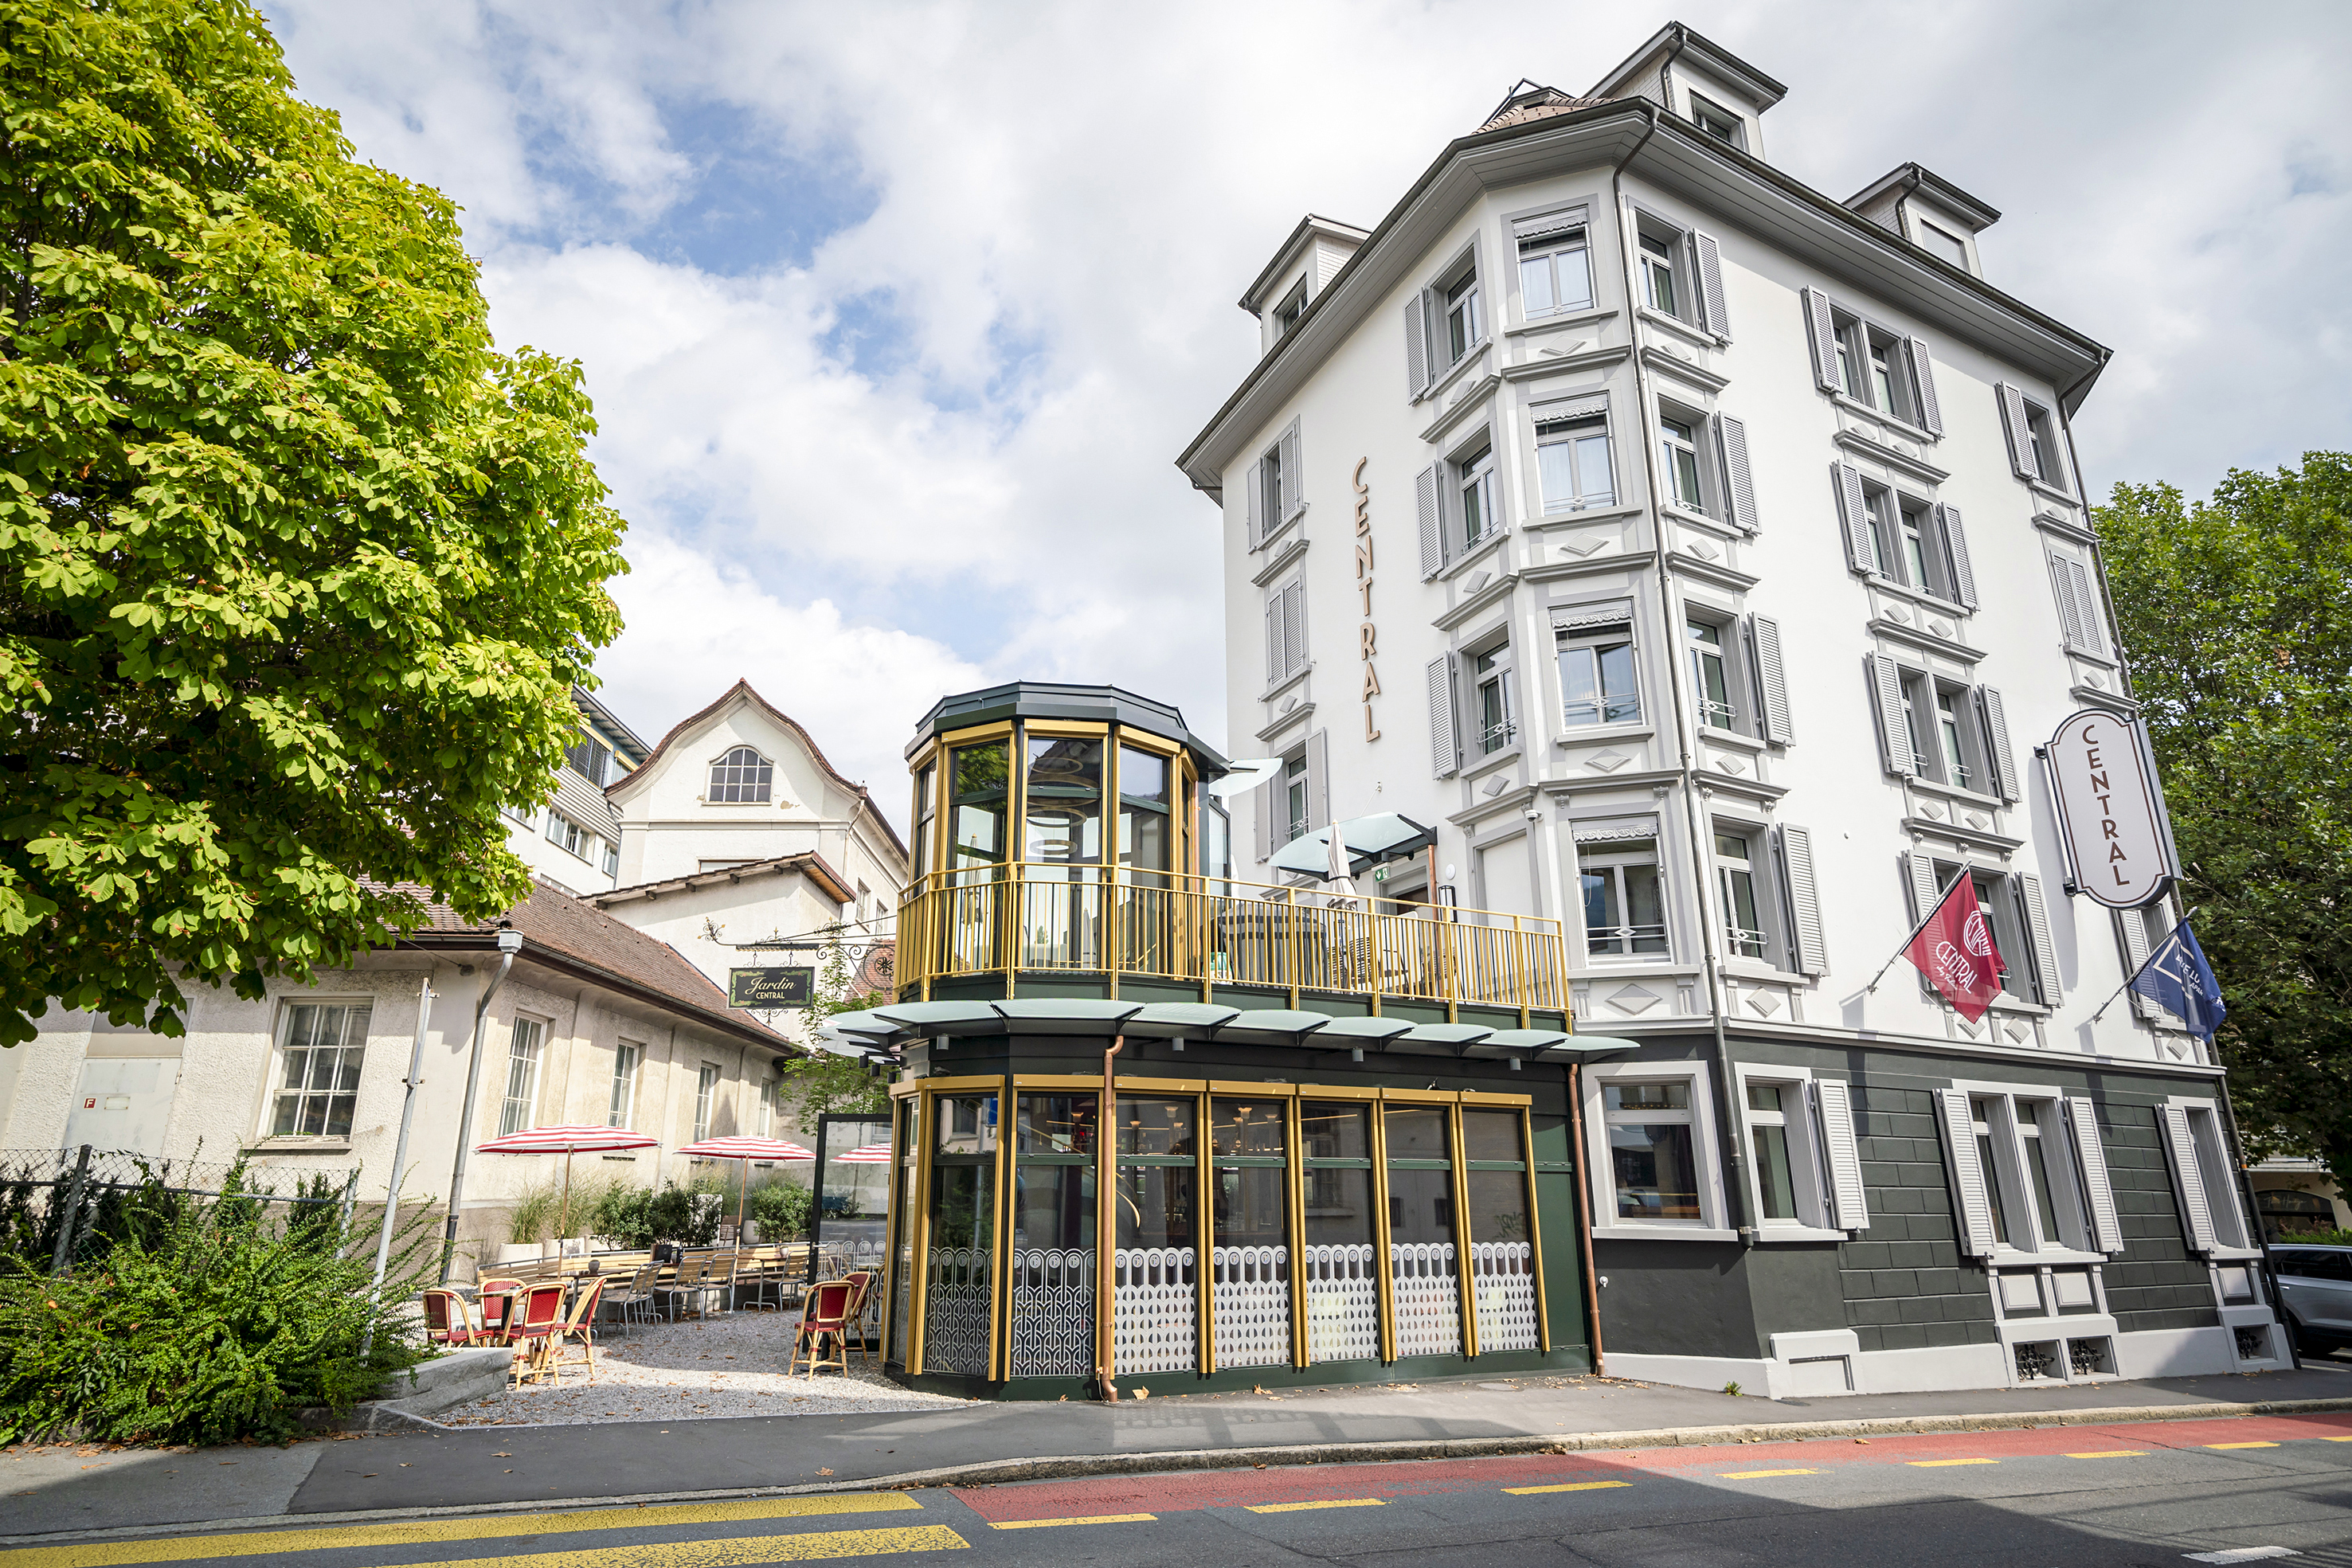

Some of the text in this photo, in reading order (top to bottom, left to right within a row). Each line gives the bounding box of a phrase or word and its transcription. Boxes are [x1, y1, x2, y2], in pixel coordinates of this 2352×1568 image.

[1352, 456, 1381, 743] CENTRAL
[2082, 724, 2130, 886] CENTRAL
[745, 976, 796, 995] Jardin
[1935, 940, 1978, 995] CENTRAL
[756, 991, 785, 999] CENTRAL
[86, 1099, 94, 1108] F
